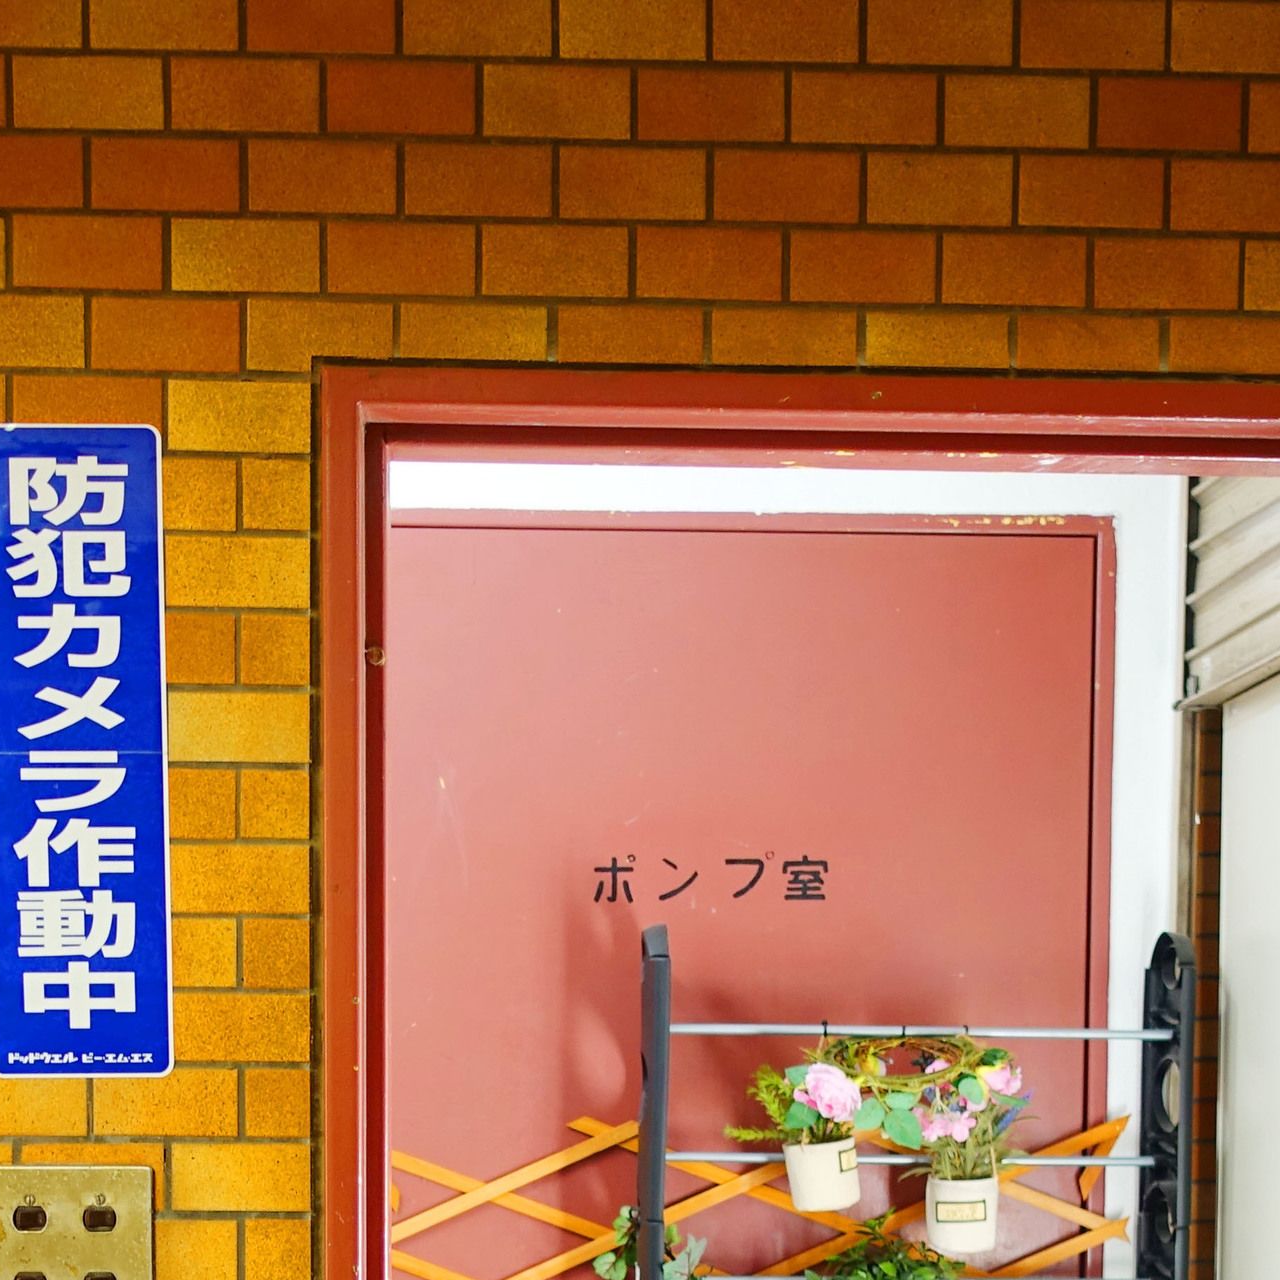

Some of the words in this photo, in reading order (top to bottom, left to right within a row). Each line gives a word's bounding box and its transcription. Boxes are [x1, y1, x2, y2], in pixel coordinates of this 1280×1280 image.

[5, 455, 137, 1030] 防犯カメラ作動中
[593, 850, 829, 903] ポンプ室
